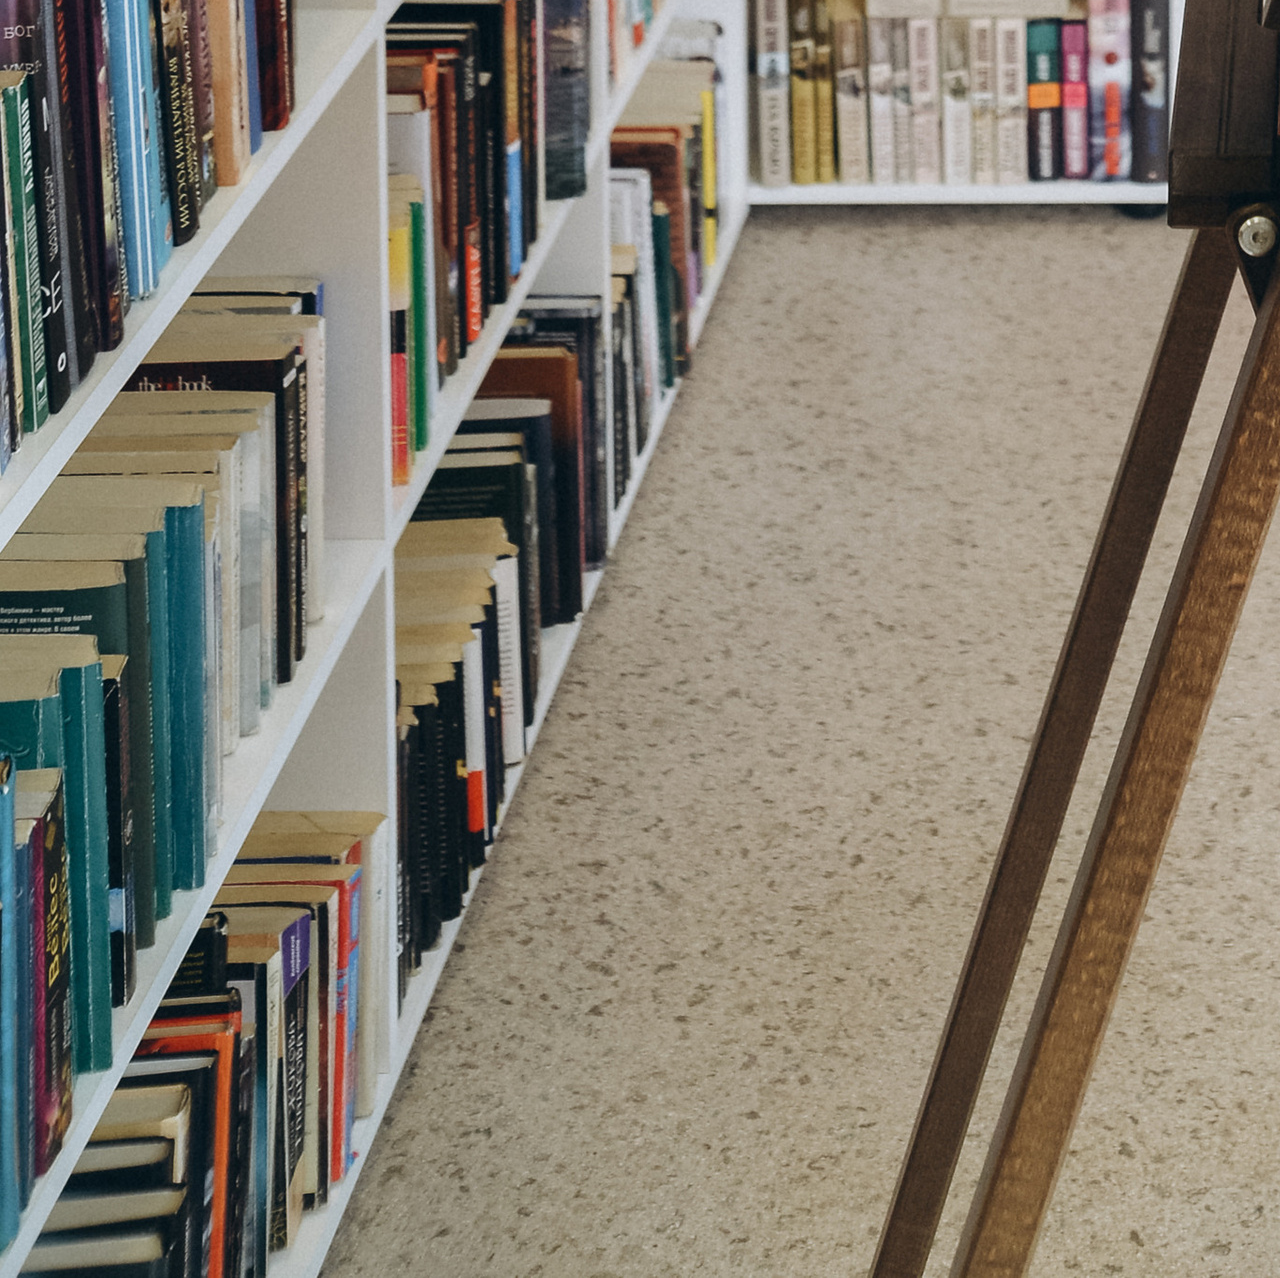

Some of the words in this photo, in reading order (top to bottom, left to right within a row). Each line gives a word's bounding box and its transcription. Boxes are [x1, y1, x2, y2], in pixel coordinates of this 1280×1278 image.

[3, 24, 36, 39] БОГ
[20, 97, 34, 196] А.БУШКОВ
[176, 161, 190, 229] РОССИИ
[26, 203, 41, 306] СОЛНЫШКО
[31, 304, 46, 374] ВОЛЧЬЕ
